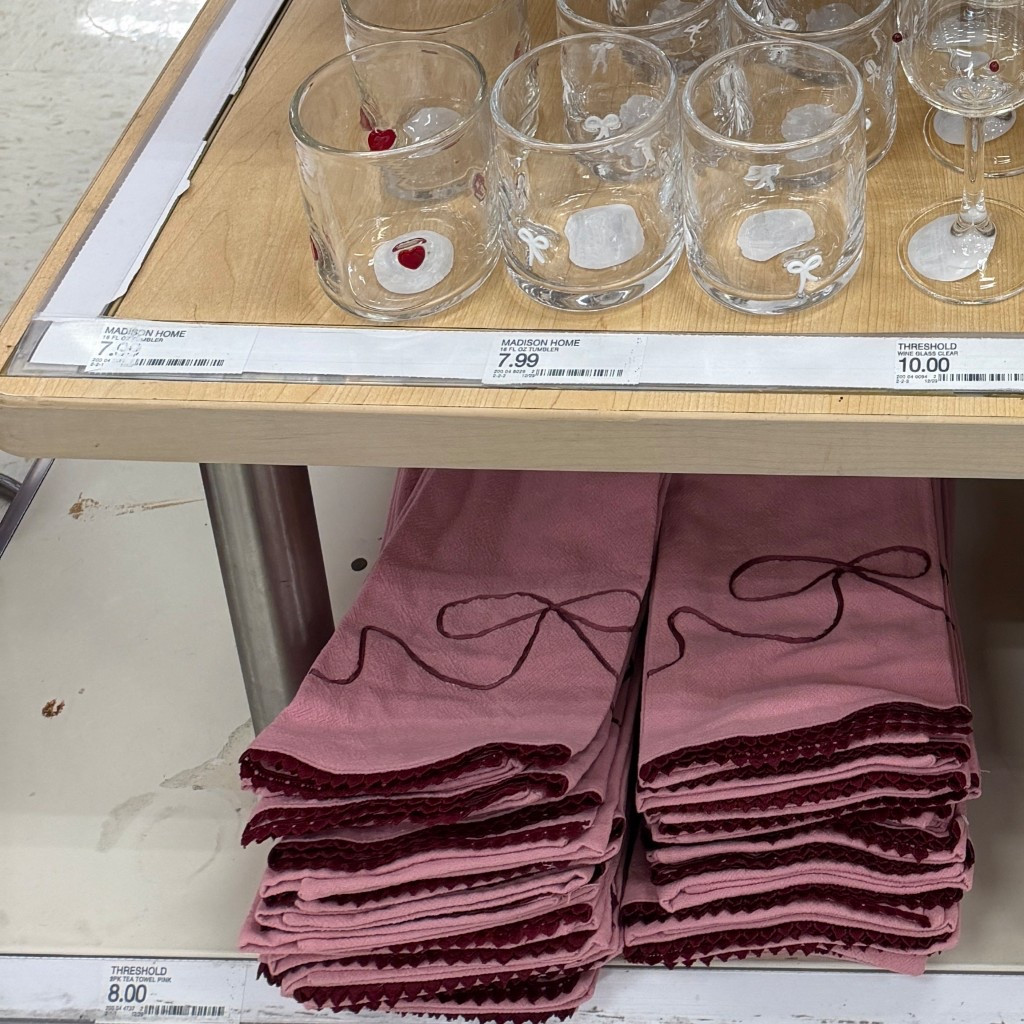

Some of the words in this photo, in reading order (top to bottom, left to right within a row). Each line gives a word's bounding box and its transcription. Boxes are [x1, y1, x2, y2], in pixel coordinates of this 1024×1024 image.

[155, 330, 187, 338] HOME
[501, 339, 548, 347] MADISON
[550, 339, 581, 347] HOME
[898, 342, 957, 350] THRESHOLD
[498, 353, 540, 368] 7.99
[898, 357, 950, 372] 10.00
[111, 966, 168, 975] THRESHOLD
[108, 983, 147, 1003] 8.00
